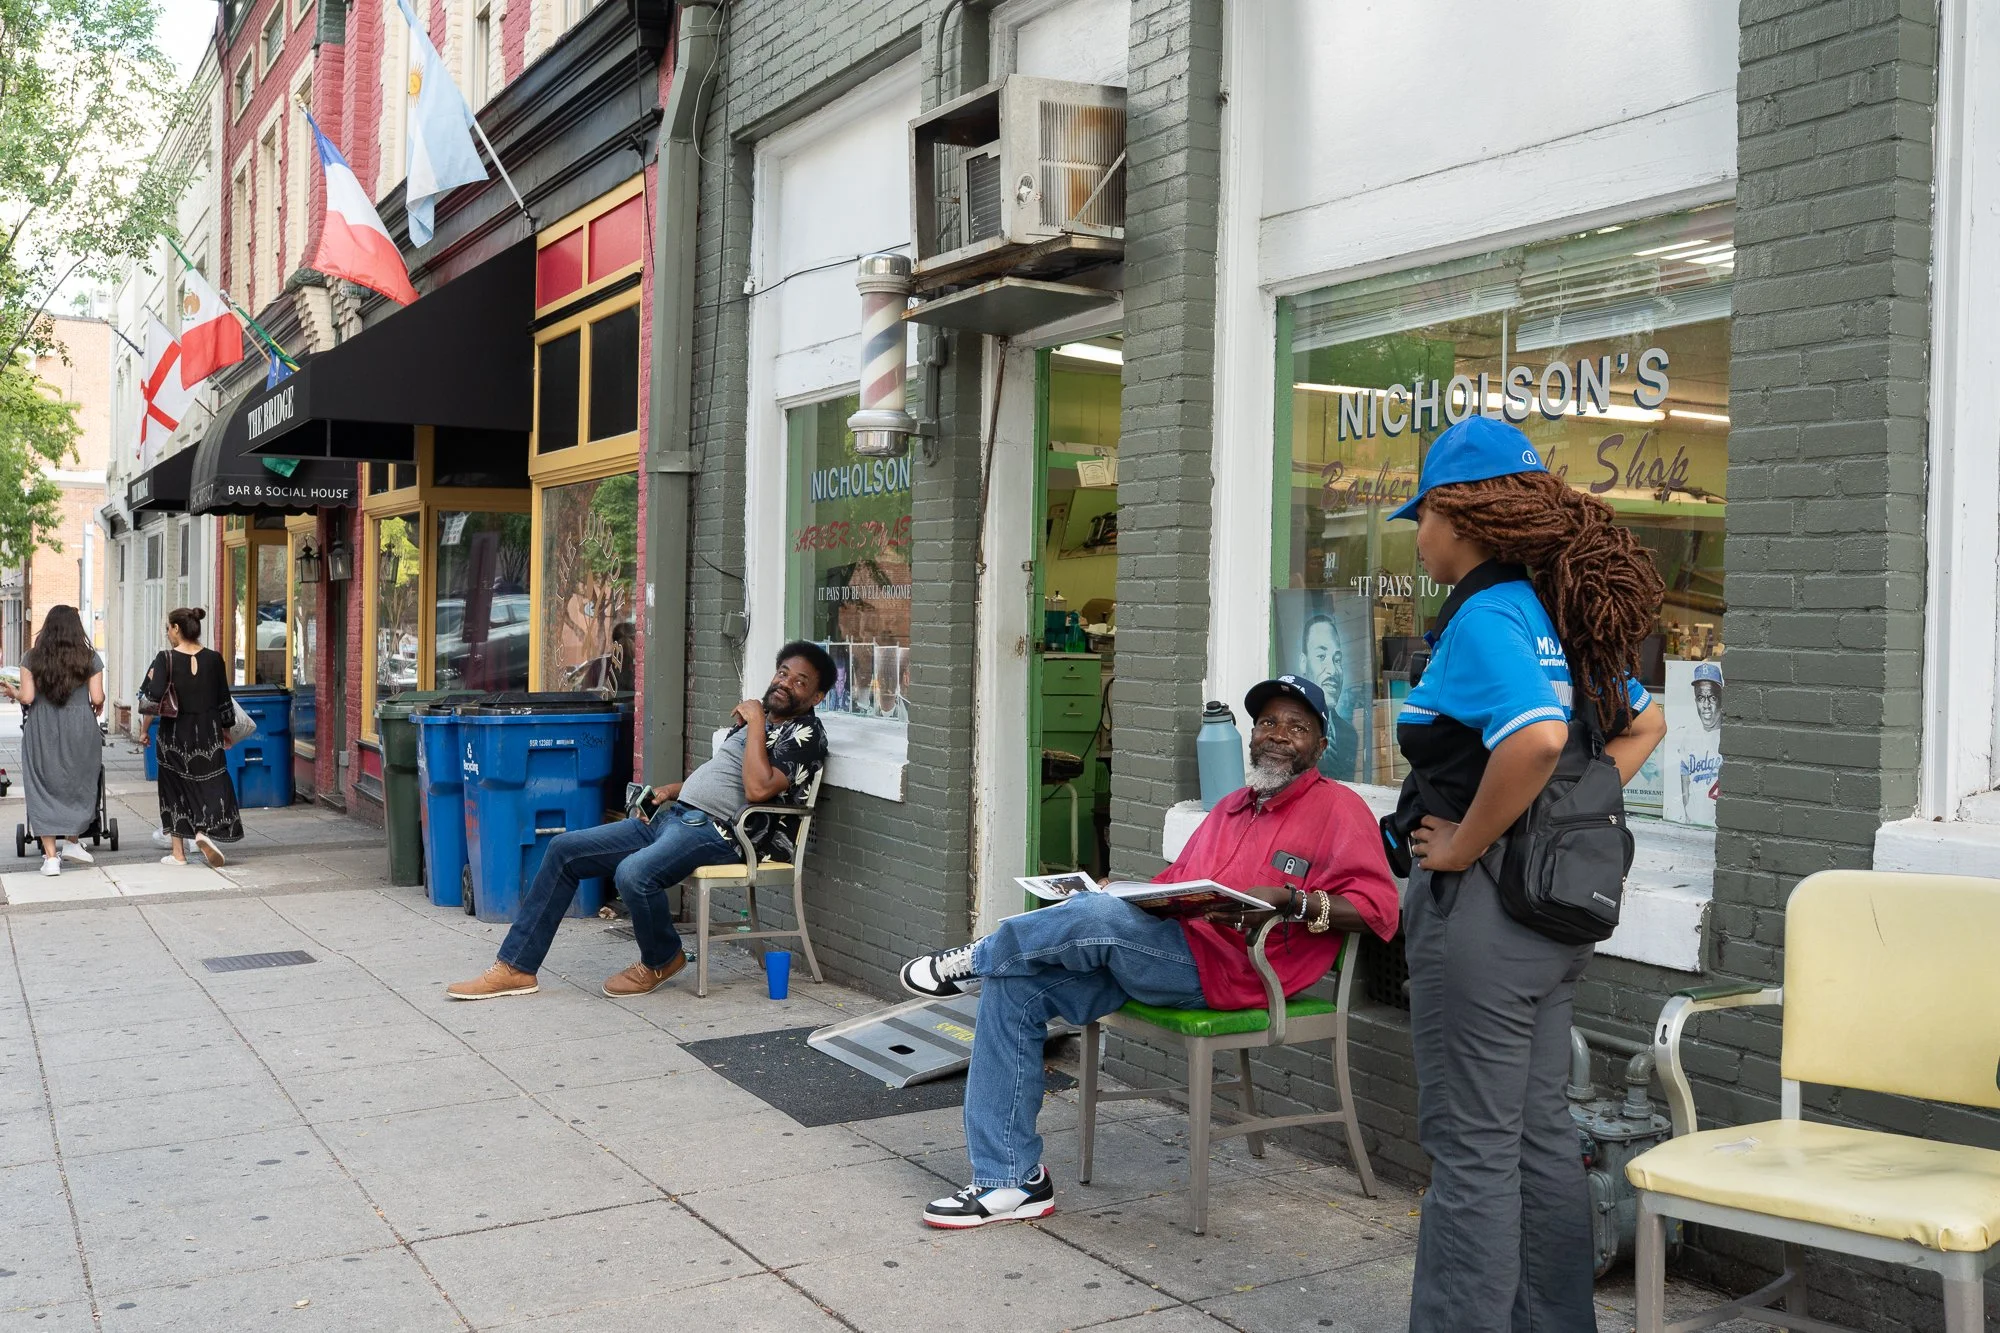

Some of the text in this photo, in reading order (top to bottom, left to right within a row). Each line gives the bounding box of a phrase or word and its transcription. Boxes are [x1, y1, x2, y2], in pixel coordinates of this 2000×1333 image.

[247, 385, 295, 441] THE BRIDGE
[1338, 348, 1670, 442] NICHOLSON'S
[811, 458, 917, 503] NICHOLSON'
[1590, 430, 1689, 505] Shop
[228, 485, 349, 499] BAR & SOCIAL HOUSE
[818, 587, 825, 601] IT
[826, 586, 840, 601] PAYS
[841, 586, 850, 600] TO
[851, 585, 860, 600] BE
[881, 584, 912, 600] GROOME
[1378, 576, 1412, 597] PAYS
[1419, 575, 1440, 597] TO
[1689, 750, 1722, 784] Dodge
